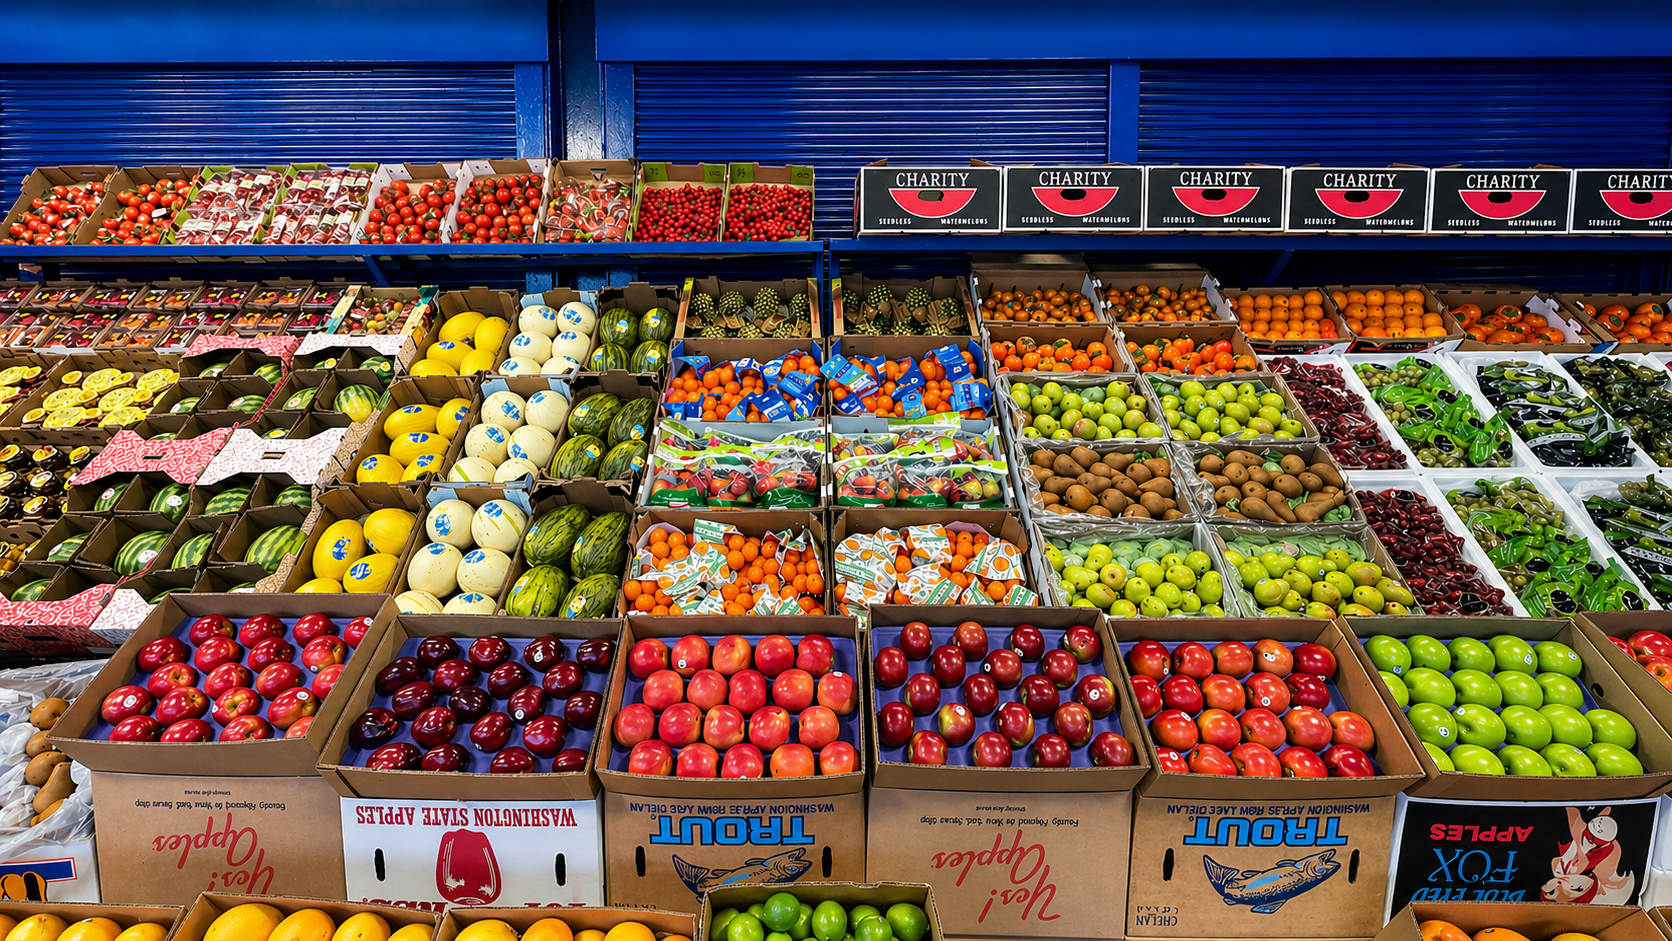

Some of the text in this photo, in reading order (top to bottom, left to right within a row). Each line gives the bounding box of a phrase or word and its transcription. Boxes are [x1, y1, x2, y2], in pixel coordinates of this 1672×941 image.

[895, 172, 970, 187] CHARITY
[1038, 171, 1112, 186] CHARITY
[1179, 171, 1253, 186] CHARITY
[1323, 173, 1397, 188] CHARITY
[1466, 174, 1541, 189] CHARITY
[1607, 174, 1672, 189] CHARIT
[355, 805, 578, 827] WASHINGTON STATE APPLES
[649, 815, 816, 846] TROUT
[1182, 816, 1349, 847] TROUT
[1429, 823, 1534, 843] APPLES
[151, 812, 258, 870] Apples
[930, 828, 1046, 887] Apples
[1427, 847, 1519, 884] FOX
[978, 864, 1061, 924] Yes!
[1135, 915, 1178, 927] CHELAN
